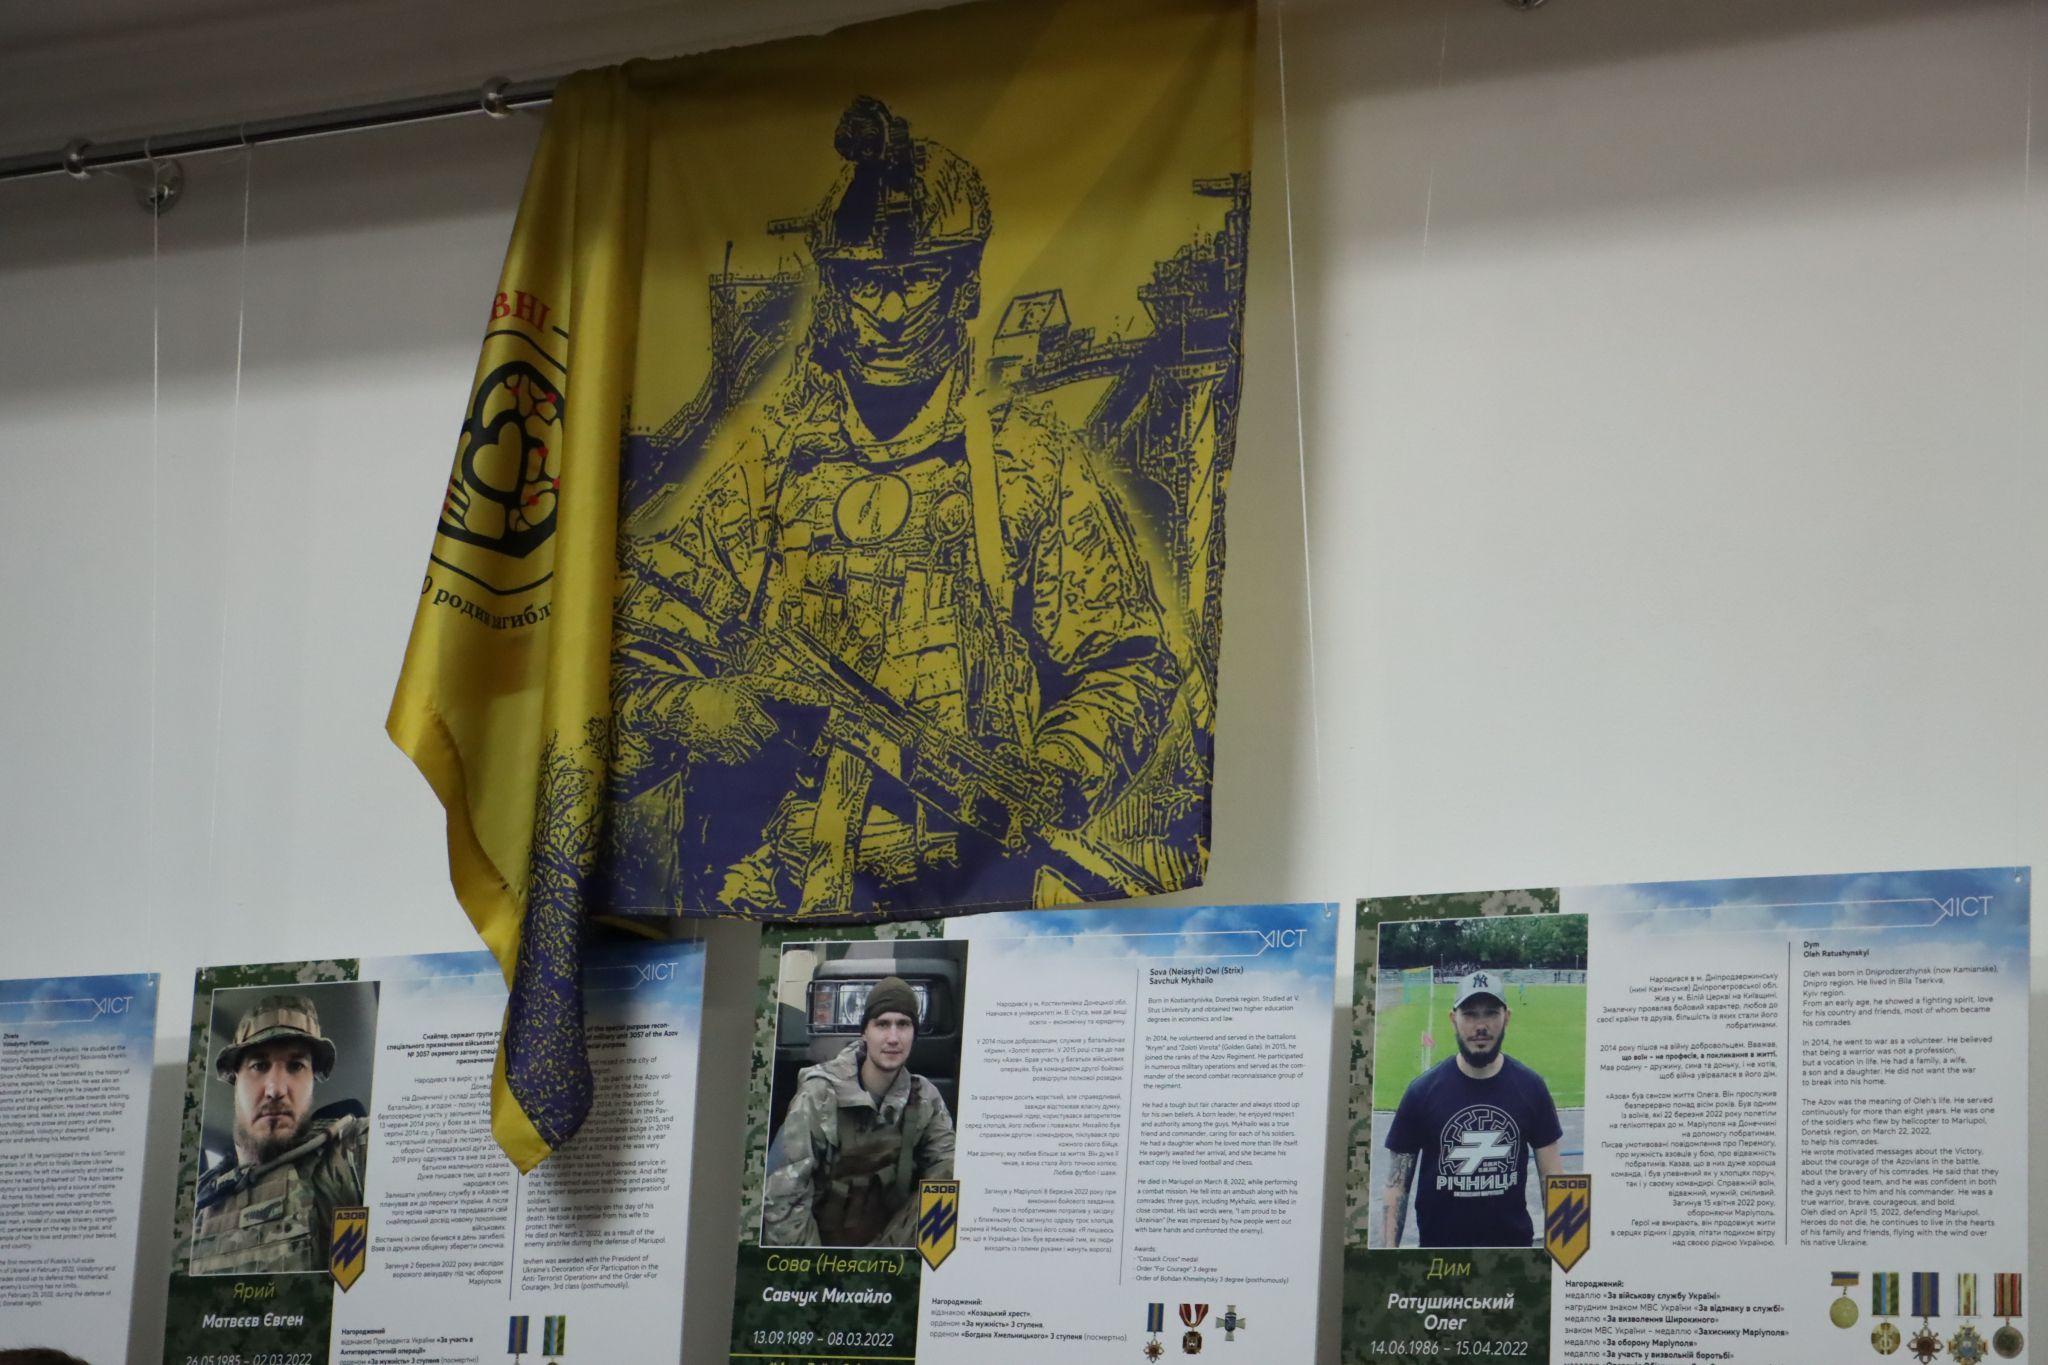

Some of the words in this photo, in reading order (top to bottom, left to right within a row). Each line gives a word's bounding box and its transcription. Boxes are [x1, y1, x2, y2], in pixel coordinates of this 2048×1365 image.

[1803, 940, 1819, 949] Dym
[1803, 979, 1827, 988] Dnipro
[1803, 989, 1818, 999] Kyiv
[1436, 1171, 1518, 1190] РІЧНИЦЯ
[1850, 1208, 1867, 1217] April
[1822, 1228, 1845, 1237] family
[1893, 1229, 1914, 1237] flying
[767, 1254, 811, 1273] Сова
[816, 1253, 904, 1276] (Неясить)
[1427, 1258, 1471, 1280] Дим
[232, 1282, 276, 1302] Ярий
[762, 1287, 817, 1306] Савчук
[821, 1288, 893, 1304] Михайло
[1387, 1293, 1515, 1314] Ратушинський
[202, 1314, 259, 1329] Матвєєв
[263, 1313, 304, 1327] Євген
[1424, 1315, 1467, 1331] Олег
[753, 1330, 814, 1345] 13.09.1989
[827, 1332, 894, 1347] 08.03.2022
[1370, 1340, 1438, 1355] 14.06.1986
[1455, 1341, 1529, 1356] 15.04.2022
